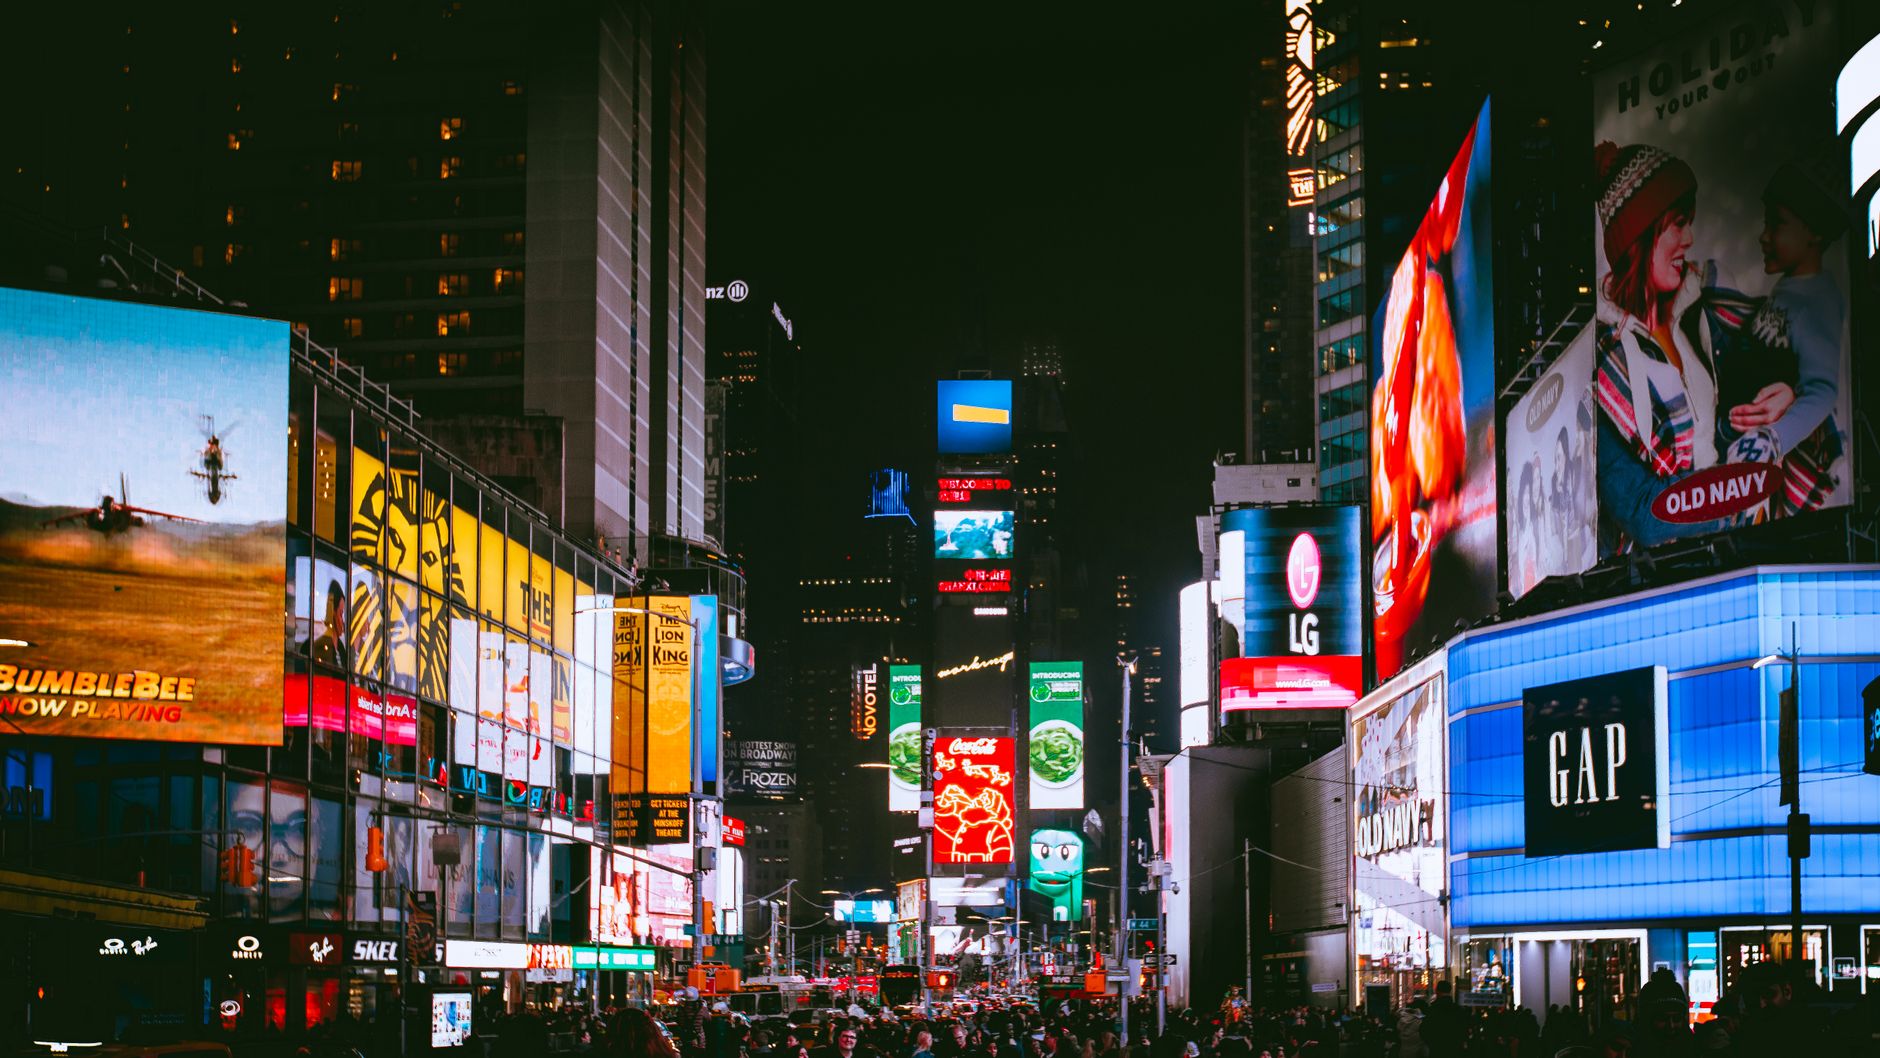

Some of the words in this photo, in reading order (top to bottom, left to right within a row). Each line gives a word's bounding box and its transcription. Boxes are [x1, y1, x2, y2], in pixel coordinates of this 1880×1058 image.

[1656, 84, 1709, 120] YOUR
[1734, 52, 1776, 84] OUT
[706, 286, 725, 299] nz
[1528, 399, 1547, 426] OLD
[1544, 379, 1561, 410] NAVY
[704, 414, 720, 521] TIMES
[1665, 485, 1706, 515] OLD
[1709, 469, 1768, 506] NAVY
[519, 581, 551, 627] THE
[655, 627, 684, 644] LION
[1289, 612, 1320, 655] LG
[653, 645, 688, 666] KING
[1032, 671, 1081, 680] INTRODUCING
[0, 698, 67, 718] NOW
[71, 701, 182, 723] PLAYING
[863, 662, 877, 740] NOVOTEL
[739, 741, 772, 750] HOTTEST
[774, 741, 796, 751] SNOW
[740, 749, 797, 760] BROADWAY!
[1548, 722, 1627, 808] GAP
[742, 769, 797, 789] FROZEN
[663, 799, 688, 808] TICKETS
[656, 829, 682, 837] THEATRE
[1358, 812, 1382, 858] OLD
[1381, 799, 1421, 851] NAVY
